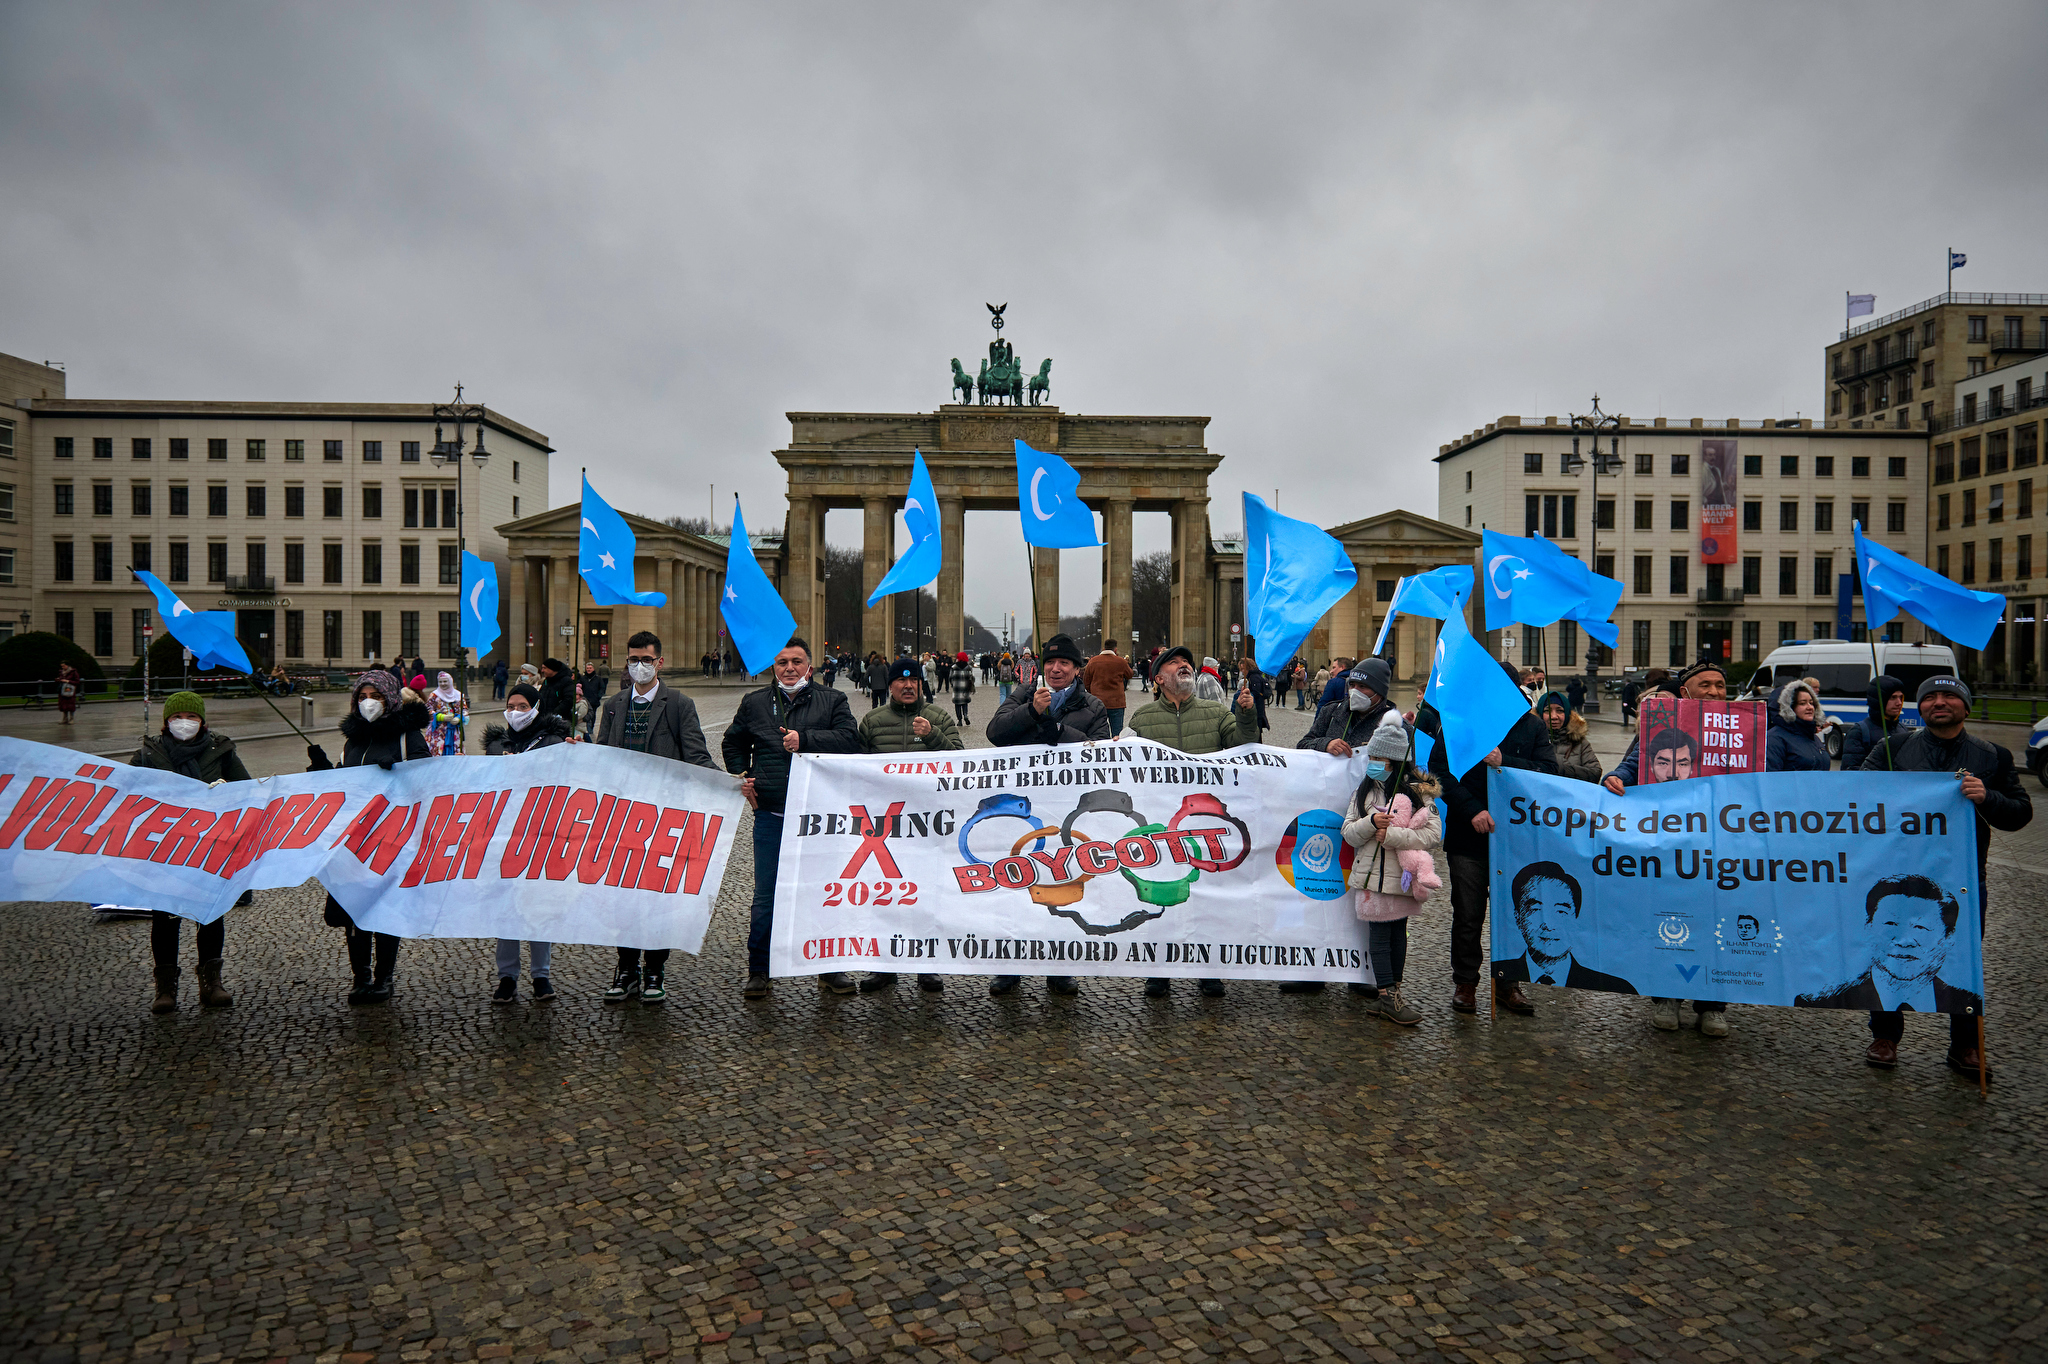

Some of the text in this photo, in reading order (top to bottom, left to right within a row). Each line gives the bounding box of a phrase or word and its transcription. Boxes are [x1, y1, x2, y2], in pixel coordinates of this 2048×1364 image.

[1704, 712, 1740, 729] FREE
[1704, 731, 1744, 748] IDRIS
[883, 761, 954, 775] CHINA
[962, 756, 1021, 773] DARF
[1029, 750, 1073, 768] FÜR
[1080, 746, 1133, 763] SEIN
[1702, 752, 1748, 768] HASAN
[937, 773, 1008, 792] NICHT
[1015, 767, 1122, 788] BELOHNT
[1130, 766, 1225, 786] WERDEN
[0, 763, 724, 895] VÖLKERMORD AN DEN UIGUREN
[797, 809, 955, 838] BEIJING
[1510, 796, 1947, 837] Stoppt den Genozid an
[953, 826, 1231, 894] BOYCOTT
[1592, 846, 1848, 890] den Uiguren!
[822, 881, 918, 907] 2022
[803, 937, 881, 960] CHINA
[890, 934, 939, 958] ÜBT
[947, 934, 1118, 962] VÖLKERMORD
[1125, 942, 1158, 962] AN
[1165, 943, 1212, 964] DEN
[1220, 944, 1316, 967] UIGUREN
[1711, 968, 1752, 977] Gesellschaft
[1711, 977, 1765, 986] bedrohte Völker
